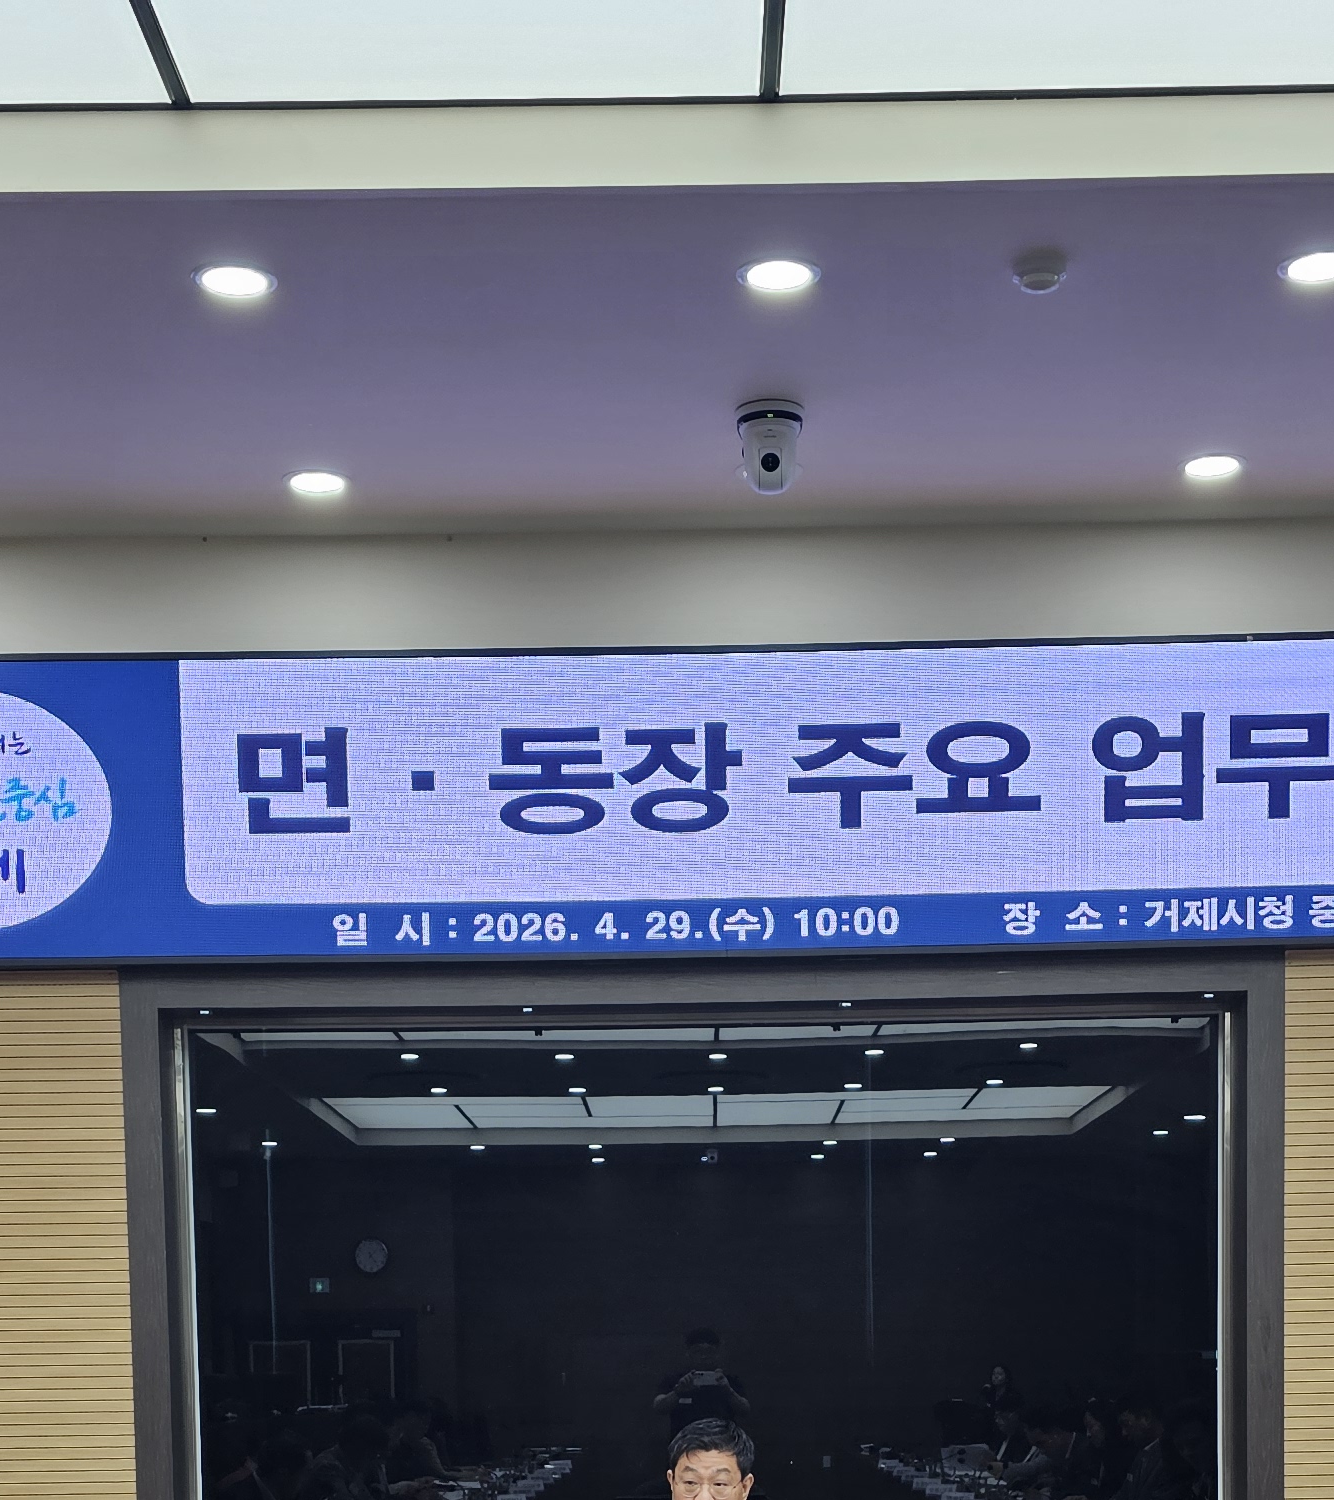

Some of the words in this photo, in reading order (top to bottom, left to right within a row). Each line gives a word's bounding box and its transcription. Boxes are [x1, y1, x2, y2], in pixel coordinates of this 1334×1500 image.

[488, 721, 744, 835] 동장
[787, 719, 1042, 829] 주요
[472, 912, 579, 943] 2026.
[594, 911, 630, 941] 4.
[793, 906, 901, 938] 10:00
[1144, 894, 1295, 933] 거제시청
